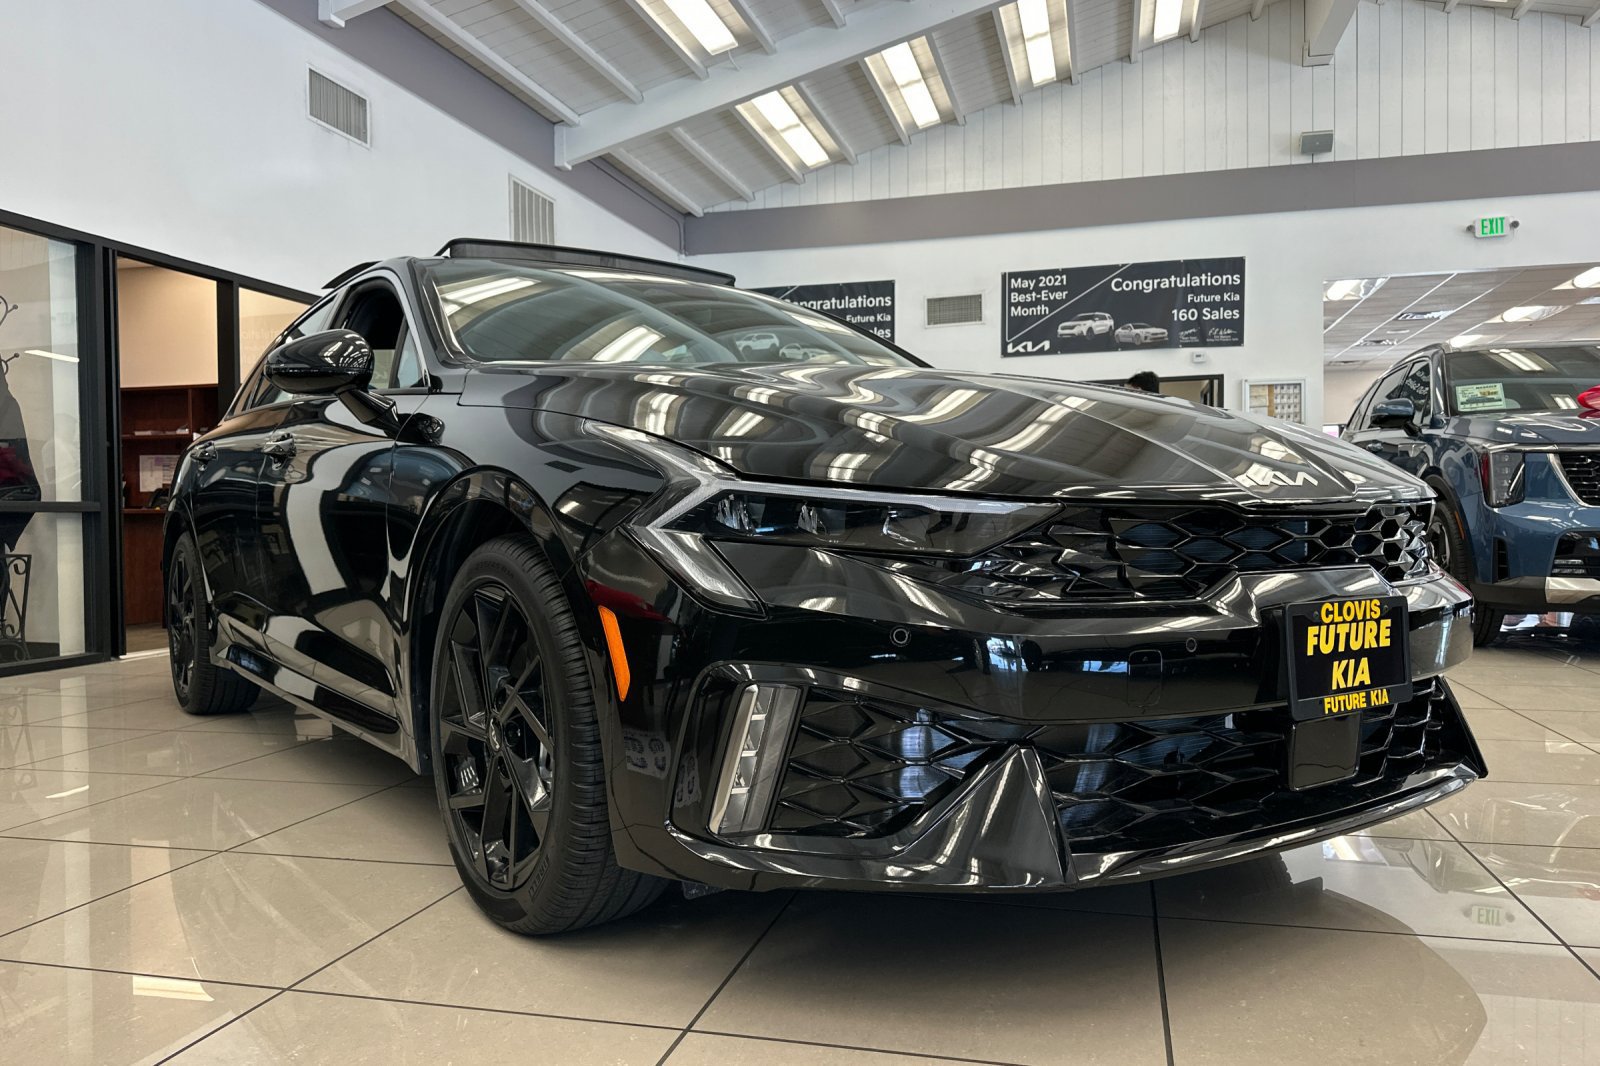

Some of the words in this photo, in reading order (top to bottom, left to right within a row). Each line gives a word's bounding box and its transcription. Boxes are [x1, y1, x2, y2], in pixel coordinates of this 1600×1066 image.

[1481, 217, 1505, 235] EXIT
[1011, 277, 1036, 290] May
[1039, 274, 1067, 287] 2021
[1111, 272, 1241, 293] Congratulations
[1011, 289, 1068, 303] Best-Ever
[1187, 294, 1221, 303] Future
[1223, 292, 1240, 301] Kia
[846, 314, 875, 323] Future
[876, 313, 892, 322] Kia
[1011, 304, 1049, 317] Month
[1171, 308, 1198, 321] 160
[1202, 307, 1240, 320] Sales
[1320, 599, 1381, 624] CLOVIS
[1307, 619, 1392, 656] FUTURE
[1332, 657, 1371, 690] KIA
[1324, 692, 1367, 714] FUTURE
[1370, 688, 1389, 706] KIA
